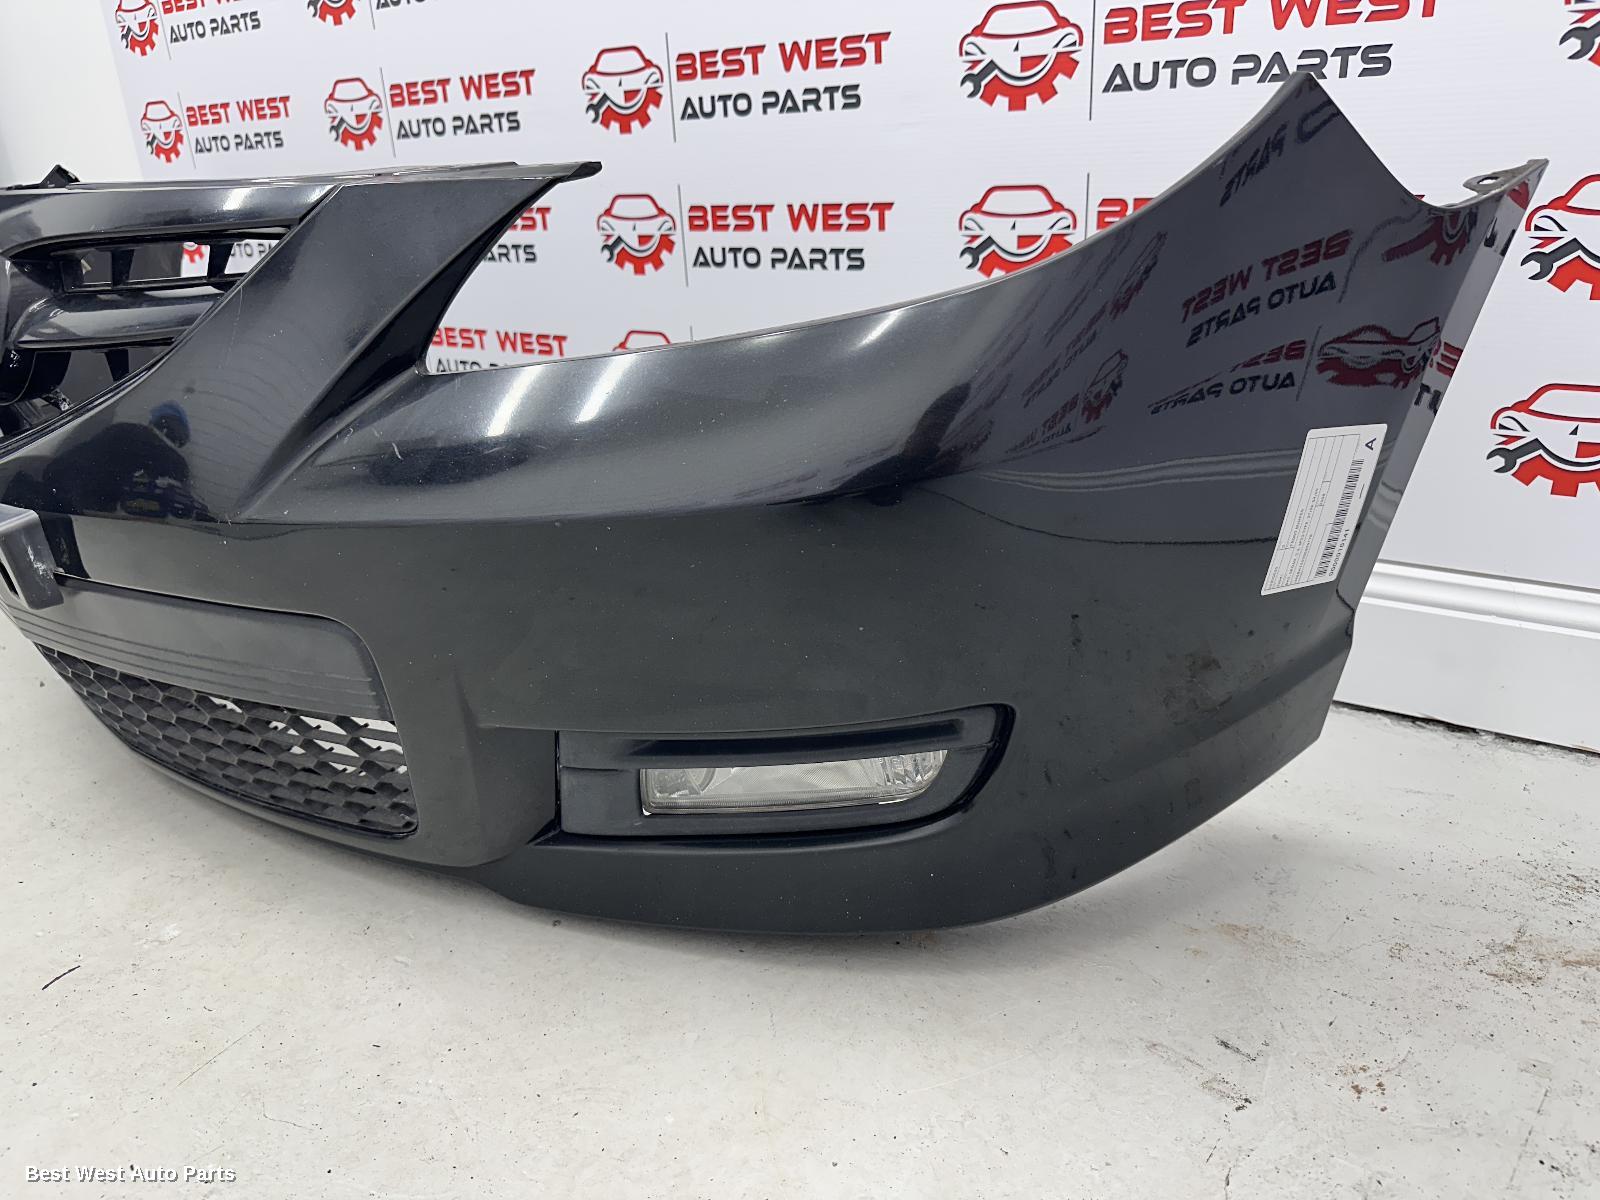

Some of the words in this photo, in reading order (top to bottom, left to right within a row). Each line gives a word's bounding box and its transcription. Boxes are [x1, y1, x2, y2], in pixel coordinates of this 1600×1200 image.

[170, 20, 206, 44] AUTO
[209, 11, 261, 37] PARTS
[1103, 0, 1248, 45] BEST
[676, 44, 766, 82] BEST
[778, 31, 892, 73] WEST
[1102, 57, 1217, 93] AUTO
[1231, 43, 1394, 86] PARTS
[389, 77, 451, 108] BEST
[460, 68, 536, 102] WEST
[680, 92, 752, 121] AUTO
[762, 83, 862, 115] PARTS
[186, 102, 230, 127] BEST
[236, 96, 290, 122] WEST
[397, 116, 446, 140] AUTO
[452, 111, 521, 136] PARTS
[195, 134, 230, 154] AUTO
[234, 130, 284, 152] PARTS
[688, 203, 775, 232] BEST
[786, 202, 895, 232] WEST
[692, 246, 761, 269] AUTO
[770, 247, 866, 271] PARTS
[432, 327, 488, 351] BEST
[496, 330, 568, 358] WEST
[1365, 437, 1377, 451] A
